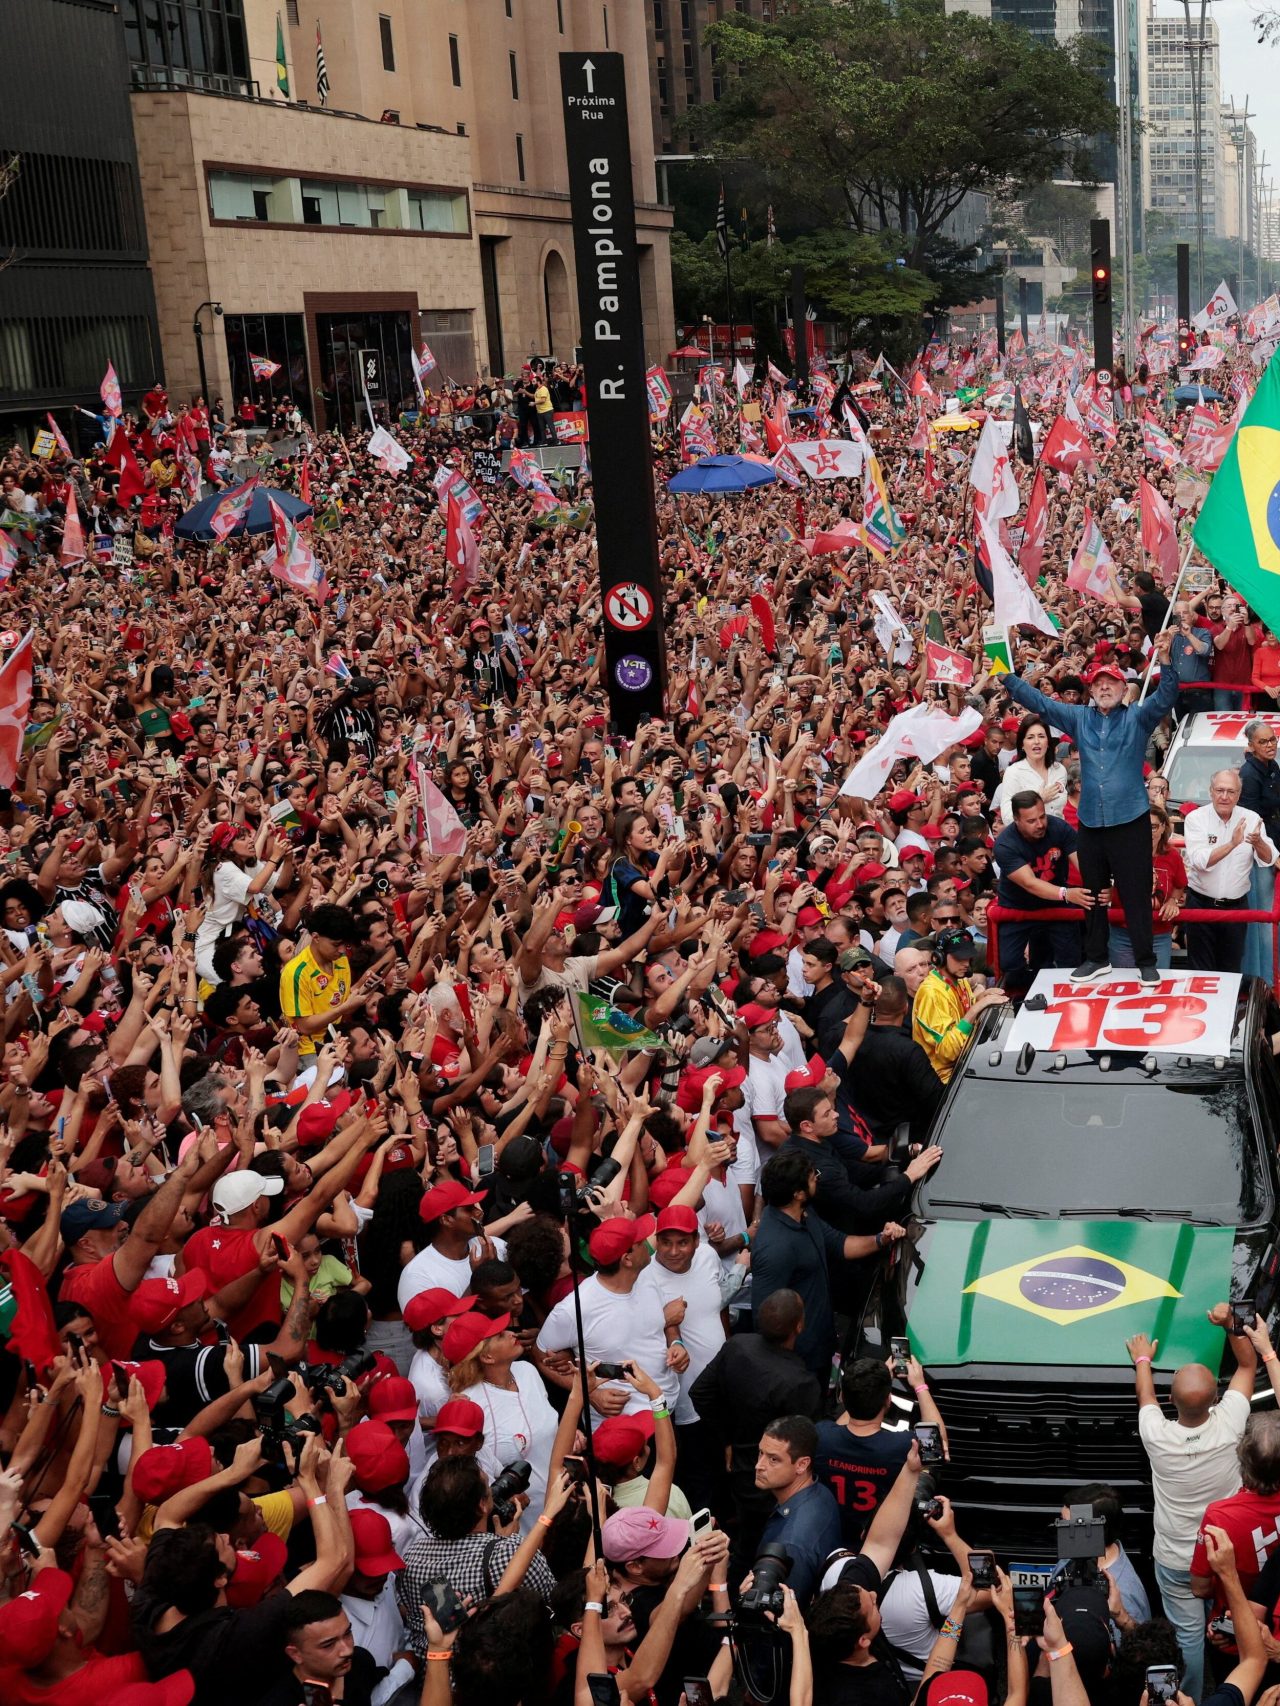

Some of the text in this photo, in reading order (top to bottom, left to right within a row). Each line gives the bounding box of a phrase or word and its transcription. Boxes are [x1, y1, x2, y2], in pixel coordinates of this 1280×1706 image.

[568, 95, 615, 106] Próxima
[582, 109, 604, 120] Rua
[587, 157, 626, 400] R. Pamplona
[1098, 373, 1110, 381] 50
[474, 452, 494, 460] PELA
[816, 454, 834, 467] 13
[475, 468, 493, 476] PELO
[622, 659, 646, 670] VOTE
[940, 664, 952, 673] PT
[1053, 976, 1220, 998] VOTE
[1043, 995, 1208, 1051] 13
[828, 1458, 888, 1475] LEANDRINHO
[829, 1474, 878, 1511] 13
